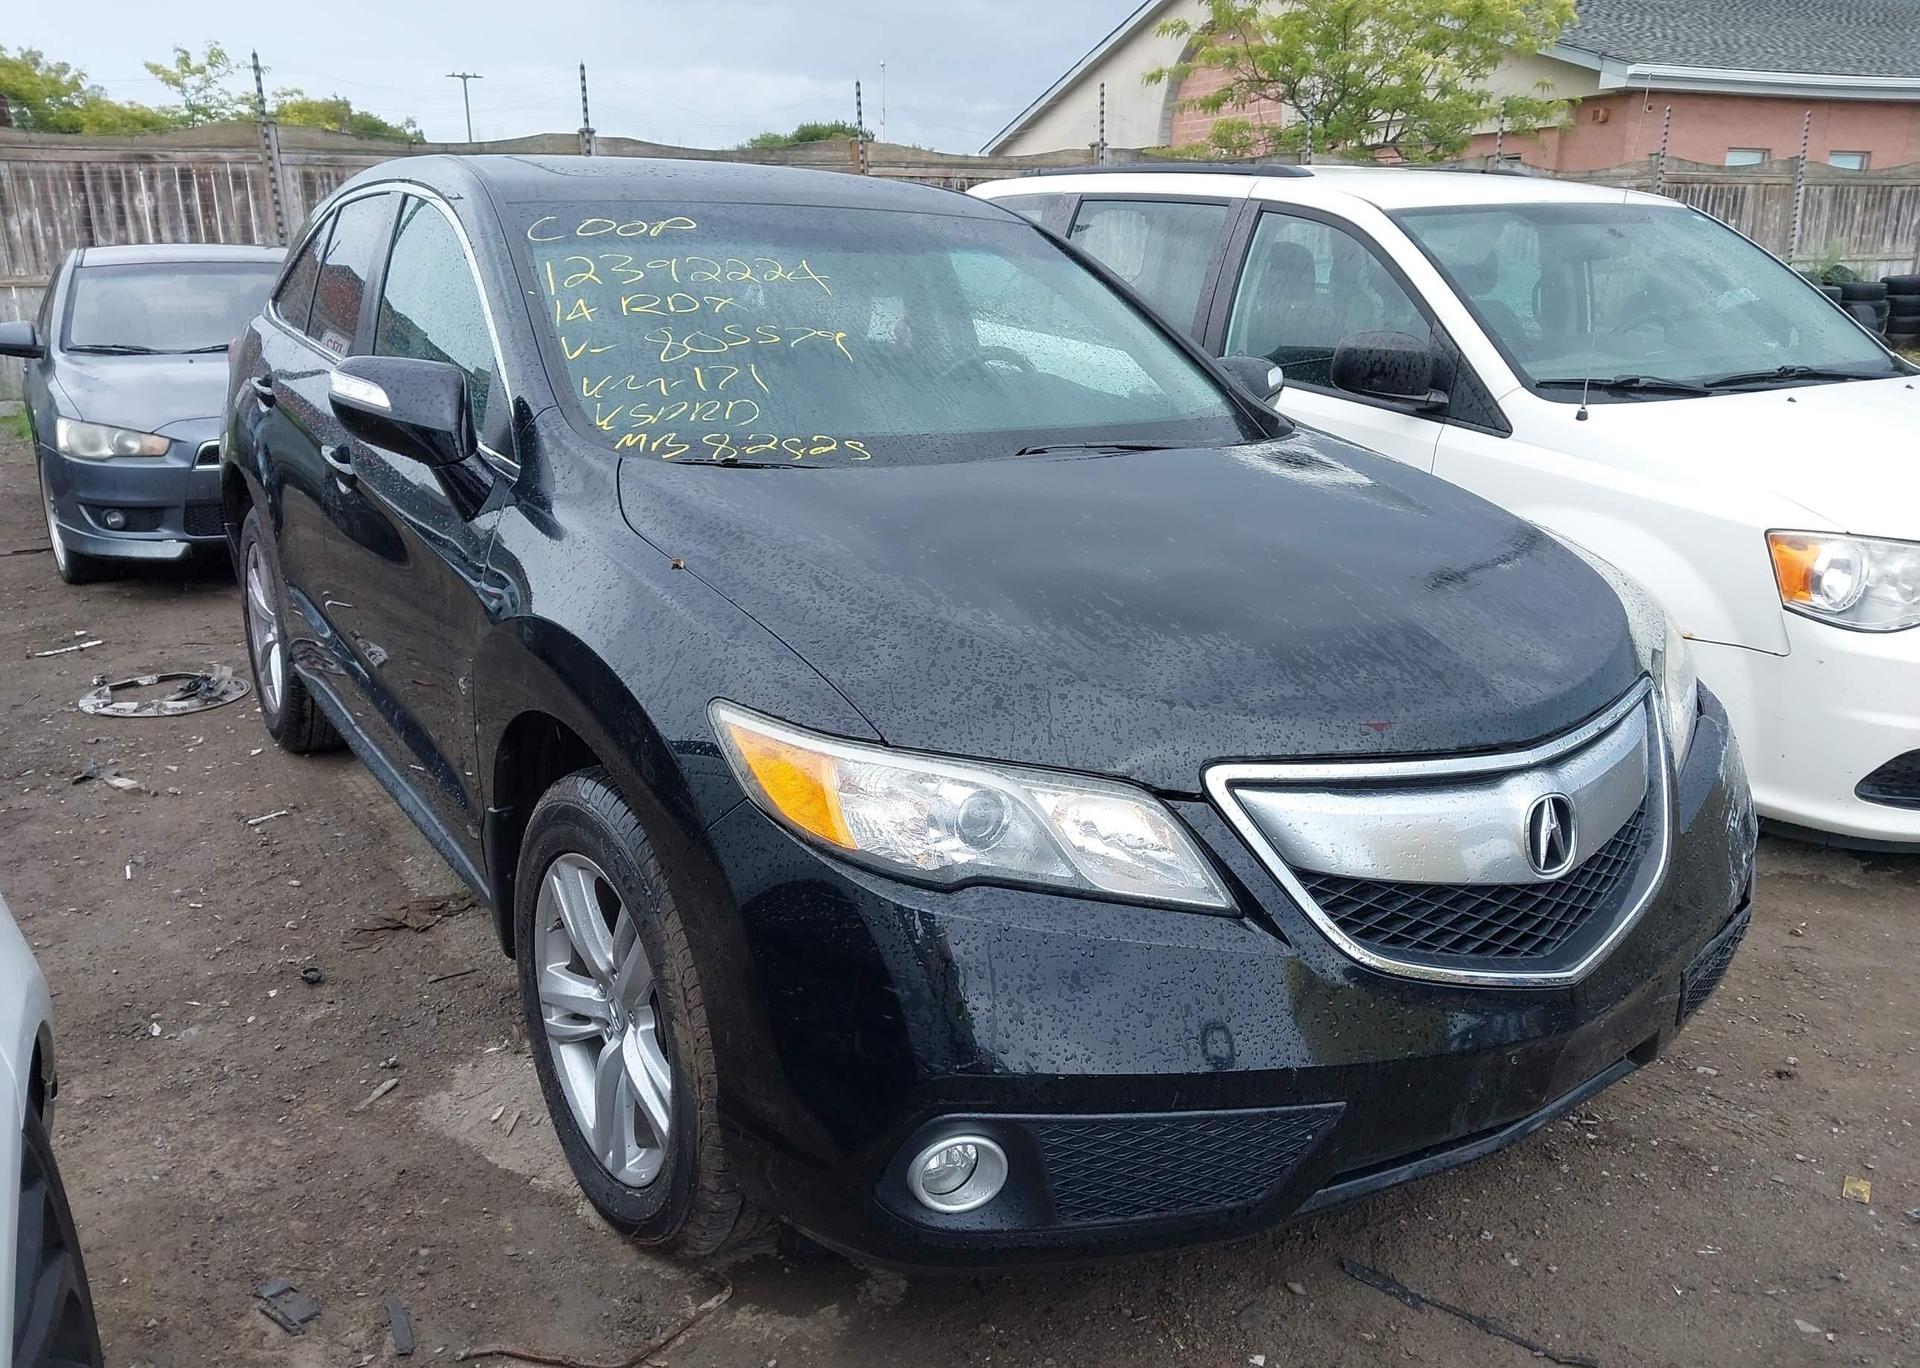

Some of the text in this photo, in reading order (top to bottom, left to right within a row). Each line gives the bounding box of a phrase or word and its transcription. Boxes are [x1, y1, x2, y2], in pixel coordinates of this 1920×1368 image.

[527, 216, 697, 242] COOP
[621, 293, 749, 317] RDX
[644, 324, 854, 363] 805579
